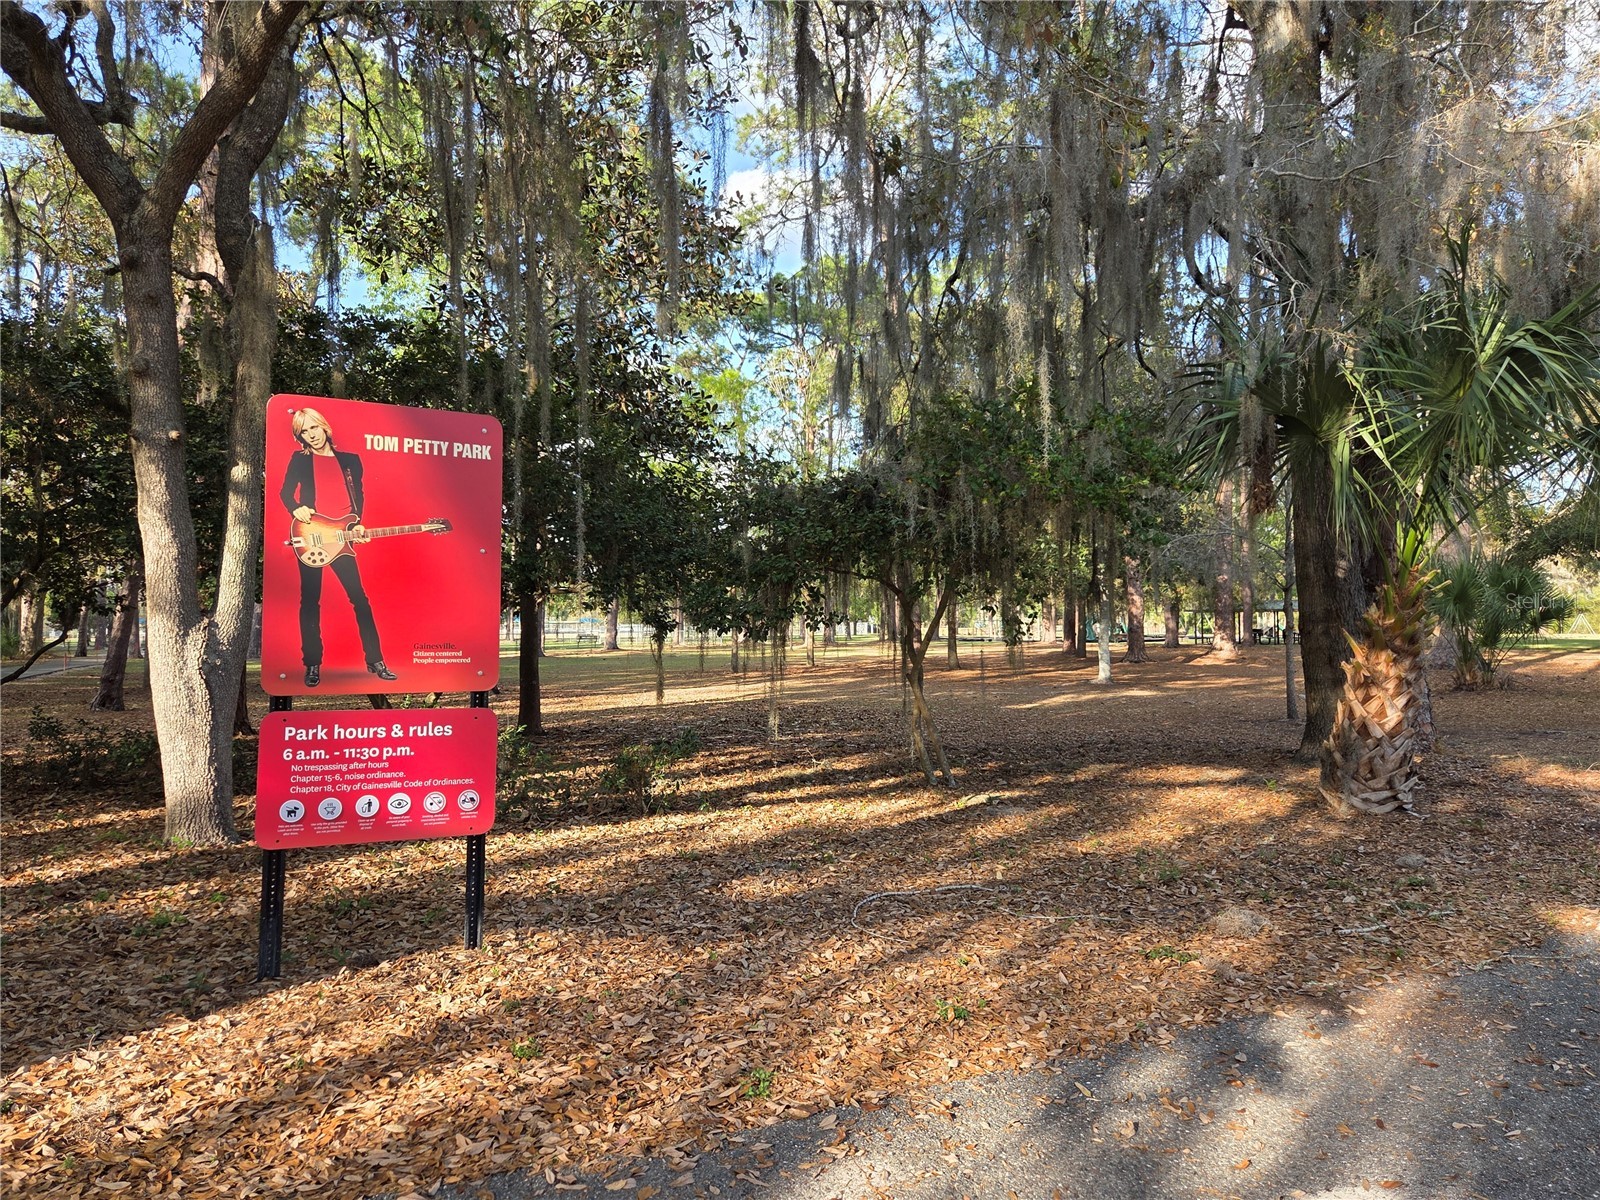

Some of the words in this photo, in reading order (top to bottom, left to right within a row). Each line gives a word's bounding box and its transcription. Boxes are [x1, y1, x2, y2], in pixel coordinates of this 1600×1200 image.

[364, 433, 399, 453] TOM
[403, 437, 449, 456] PETTY
[453, 442, 492, 460] PARK
[284, 724, 328, 741] Park
[333, 724, 387, 740] hours
[390, 723, 404, 738] &
[408, 721, 453, 737] rules
[282, 748, 293, 761] 6
[296, 749, 330, 760] a.m.
[343, 747, 380, 760] 11:30
[382, 746, 415, 760] p.m.
[291, 764, 303, 772] No
[304, 762, 348, 772] trespassing
[348, 761, 367, 770] after
[367, 761, 389, 769] hours
[290, 774, 323, 783] Chapter
[324, 774, 343, 782] 15-6,
[344, 772, 365, 780] noise
[366, 771, 406, 780] ordinance.
[289, 785, 322, 794] Chapter
[323, 784, 334, 793] 18,
[335, 783, 351, 793] City
[352, 782, 361, 790] of
[361, 780, 402, 790] Gainesville
[403, 780, 423, 788] Code
[424, 779, 432, 787] of
[432, 778, 475, 786] Ordinances.
